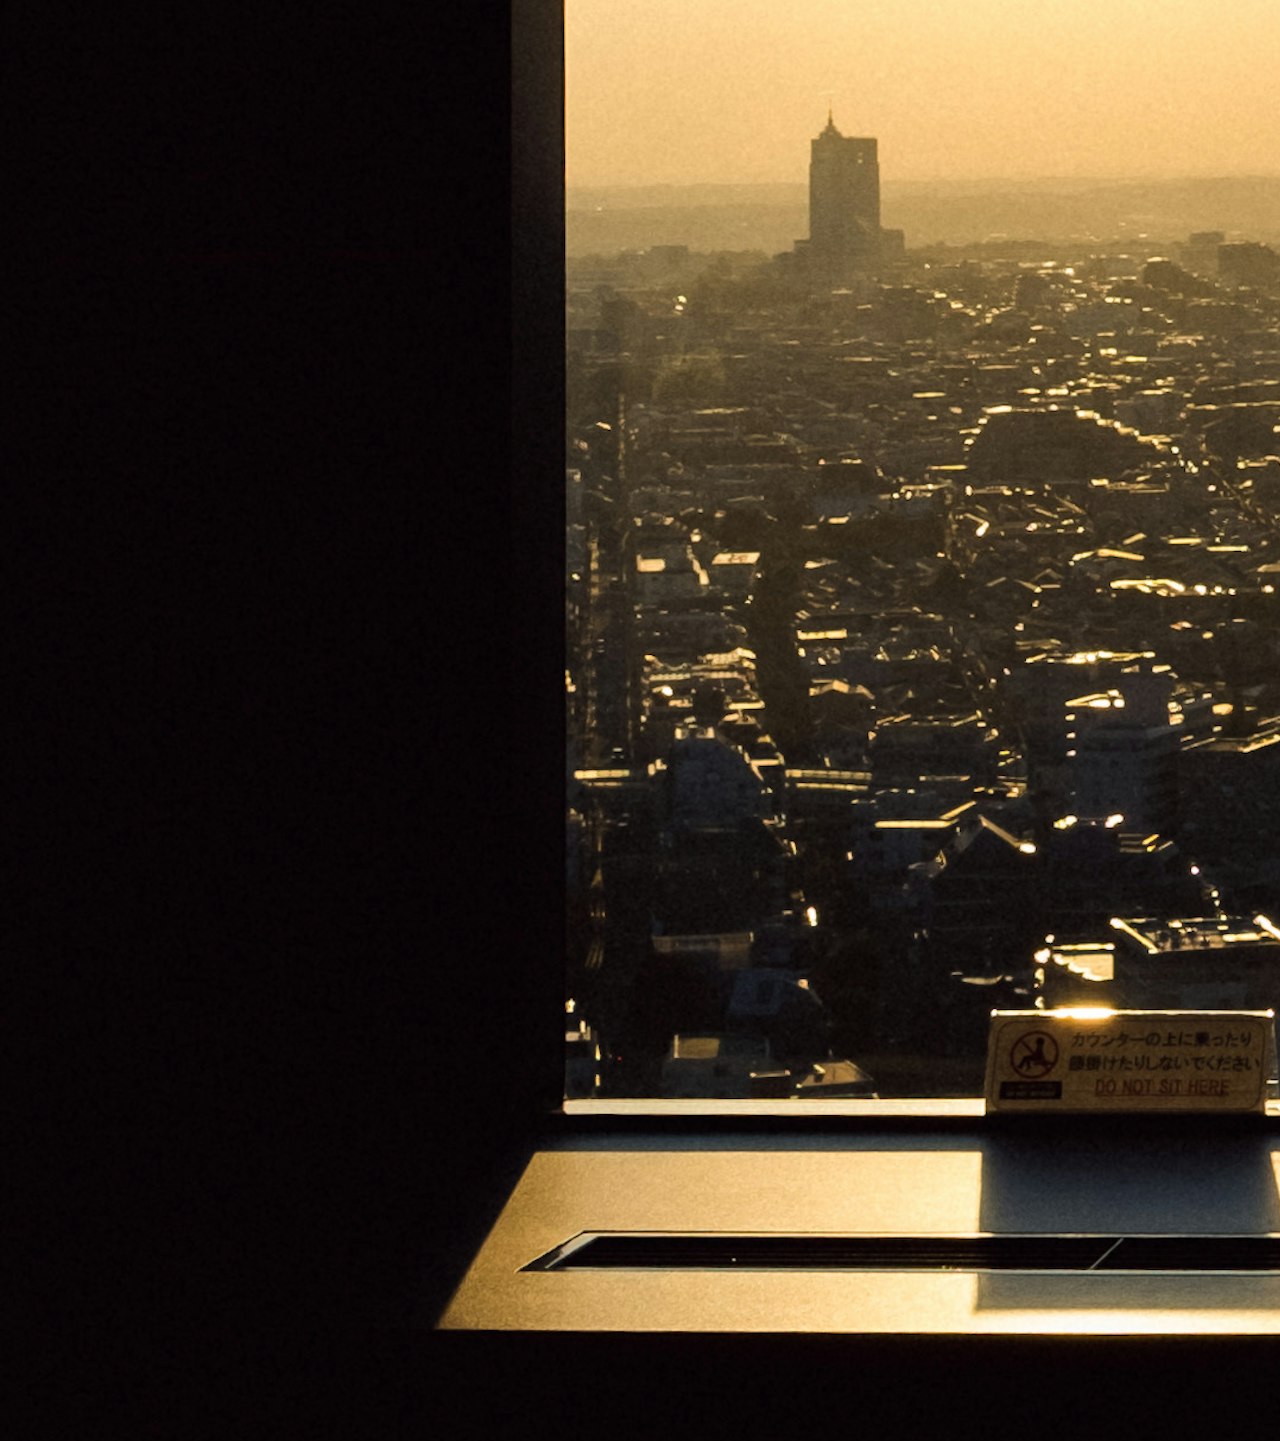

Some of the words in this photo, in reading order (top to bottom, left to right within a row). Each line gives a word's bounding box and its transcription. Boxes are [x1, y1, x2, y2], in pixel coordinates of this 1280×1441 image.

[1095, 1079, 1117, 1094] DO
[1122, 1079, 1152, 1094] NOT
[1188, 1078, 1231, 1094] HERE
